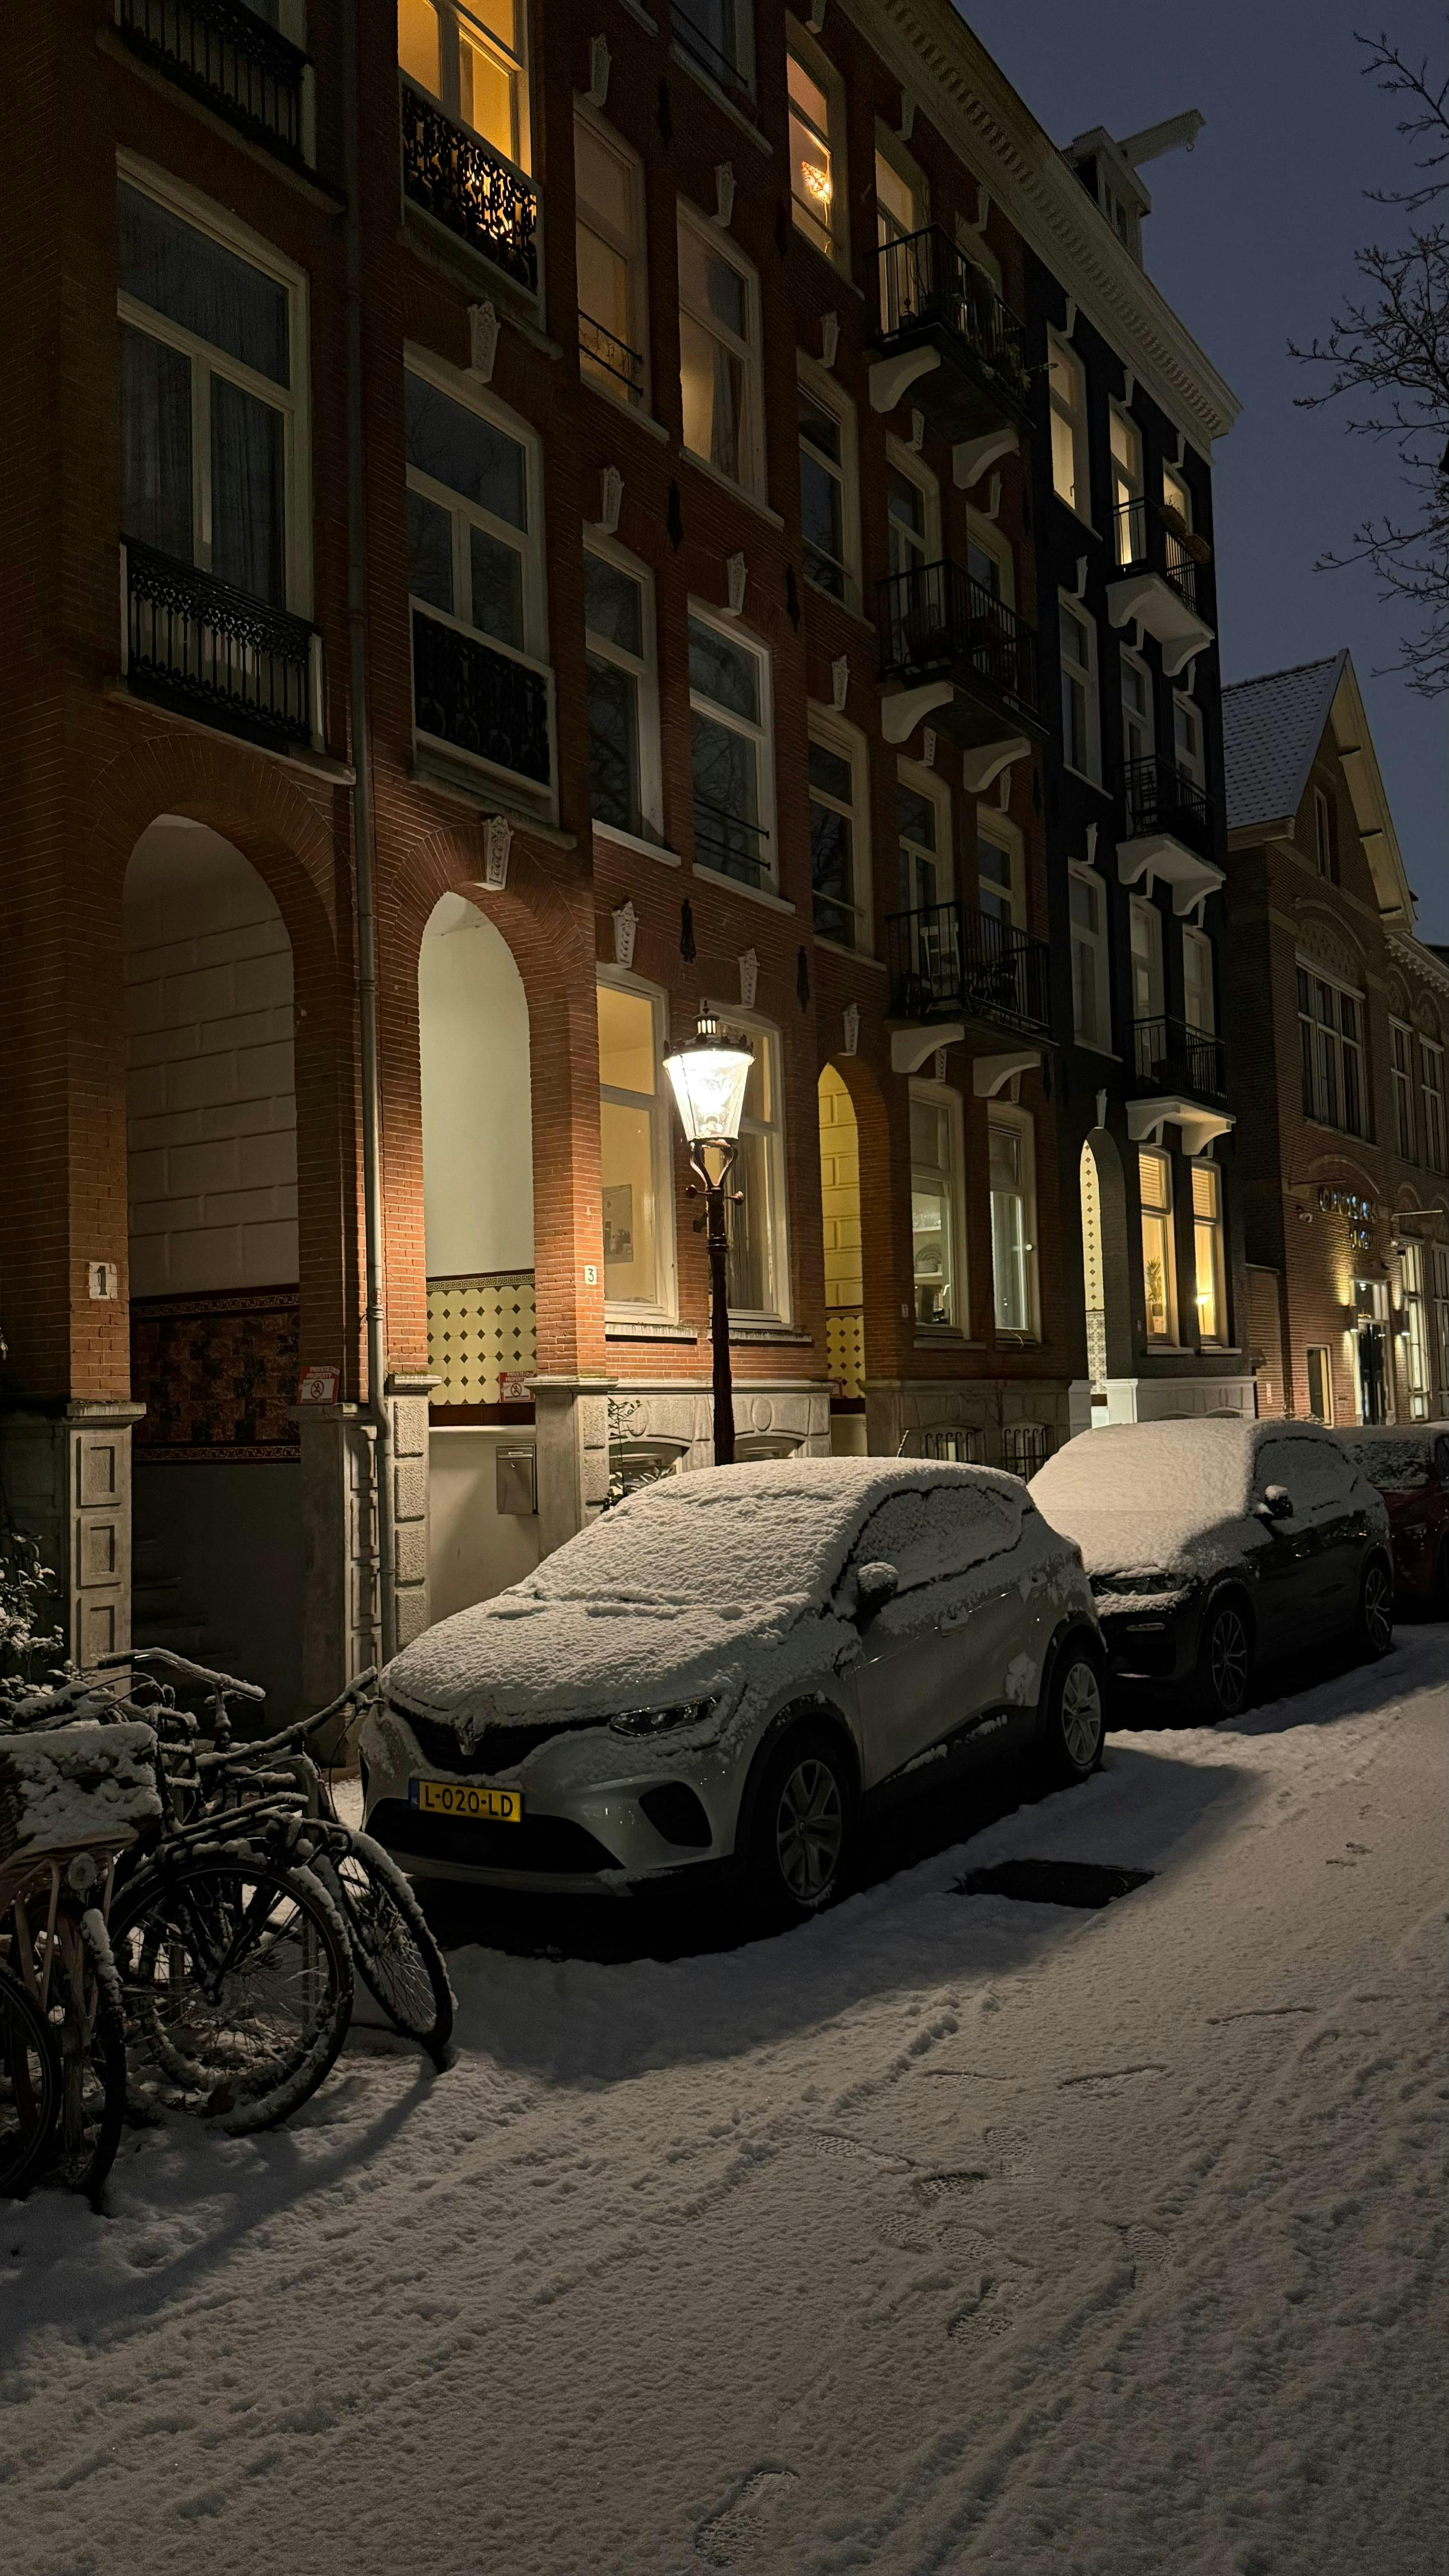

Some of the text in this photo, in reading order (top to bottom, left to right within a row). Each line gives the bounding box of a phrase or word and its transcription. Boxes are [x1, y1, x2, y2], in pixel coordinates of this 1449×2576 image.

[97, 1266, 107, 1295] 1
[588, 1268, 594, 1282] 3
[425, 1785, 514, 1817] L-020-LD
